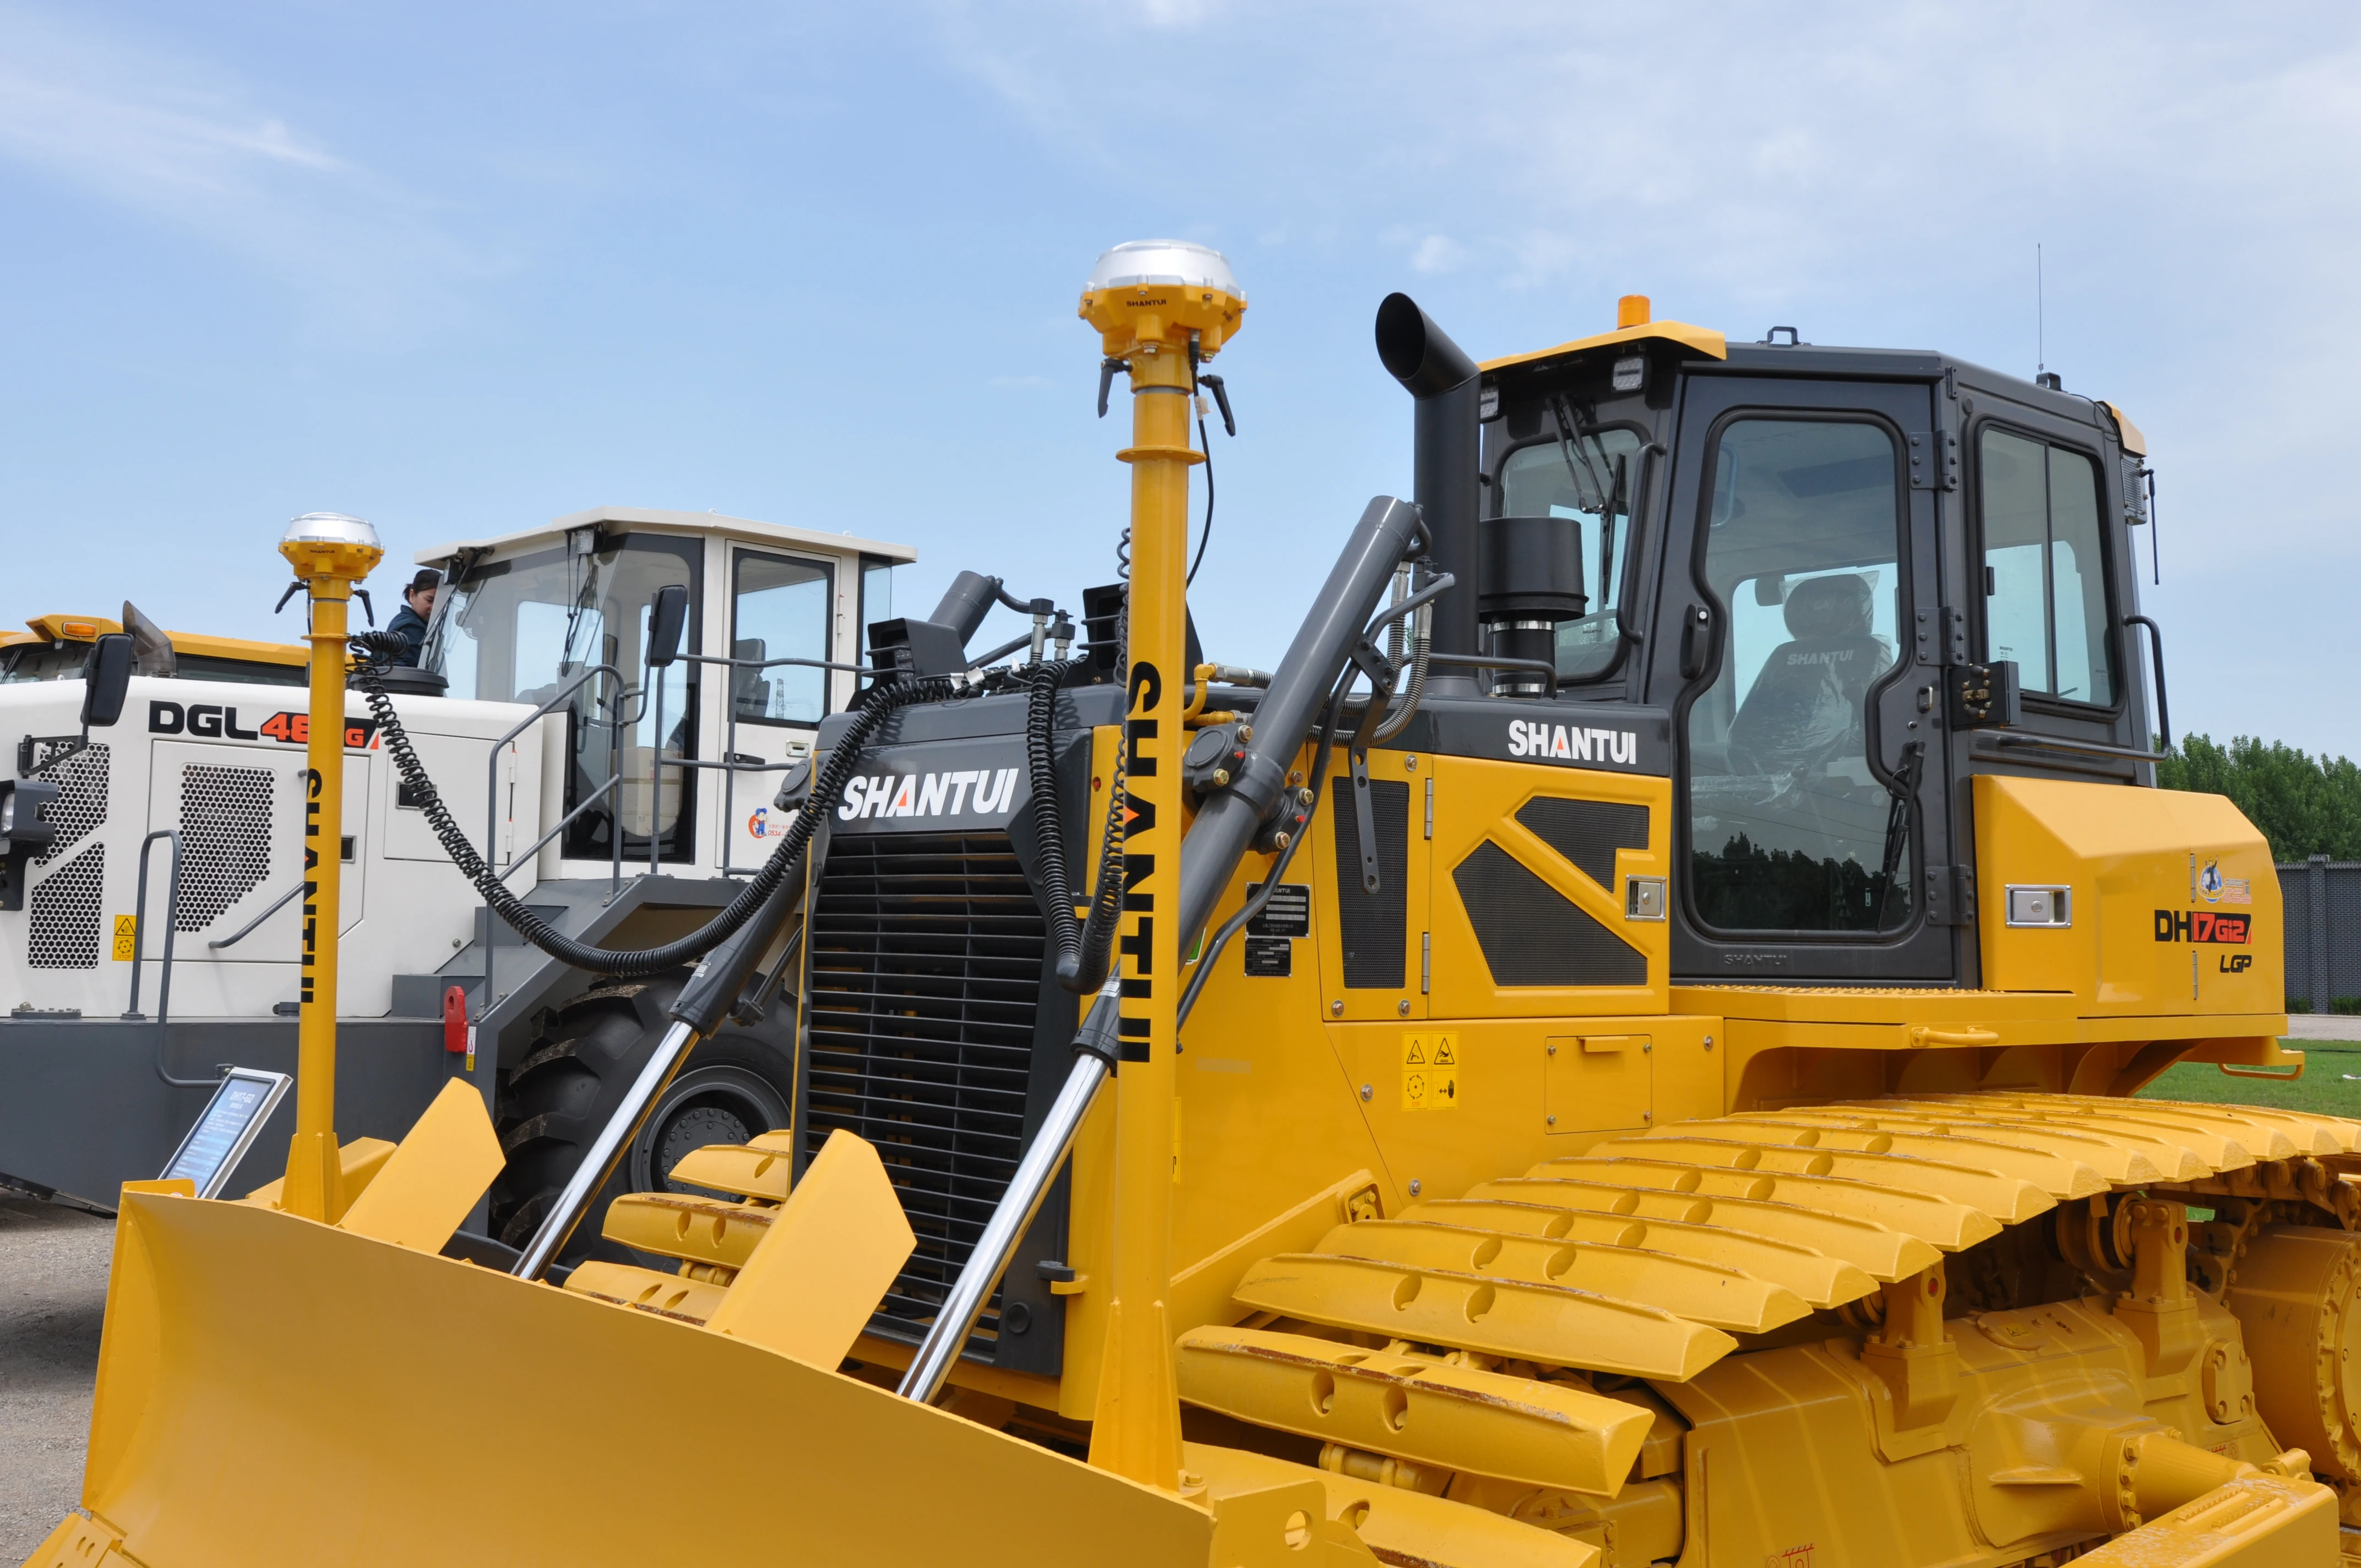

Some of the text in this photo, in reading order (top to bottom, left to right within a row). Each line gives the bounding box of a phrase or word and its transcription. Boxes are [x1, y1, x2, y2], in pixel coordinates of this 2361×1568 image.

[1787, 650, 1854, 665] SHANTUI
[1508, 719, 1636, 765] SHANTUI
[838, 768, 1019, 820] SHANTUI
[1118, 661, 1162, 1064] SHANTUI
[1724, 954, 1787, 965] SHANTUI
[2219, 954, 2253, 973] LGP
